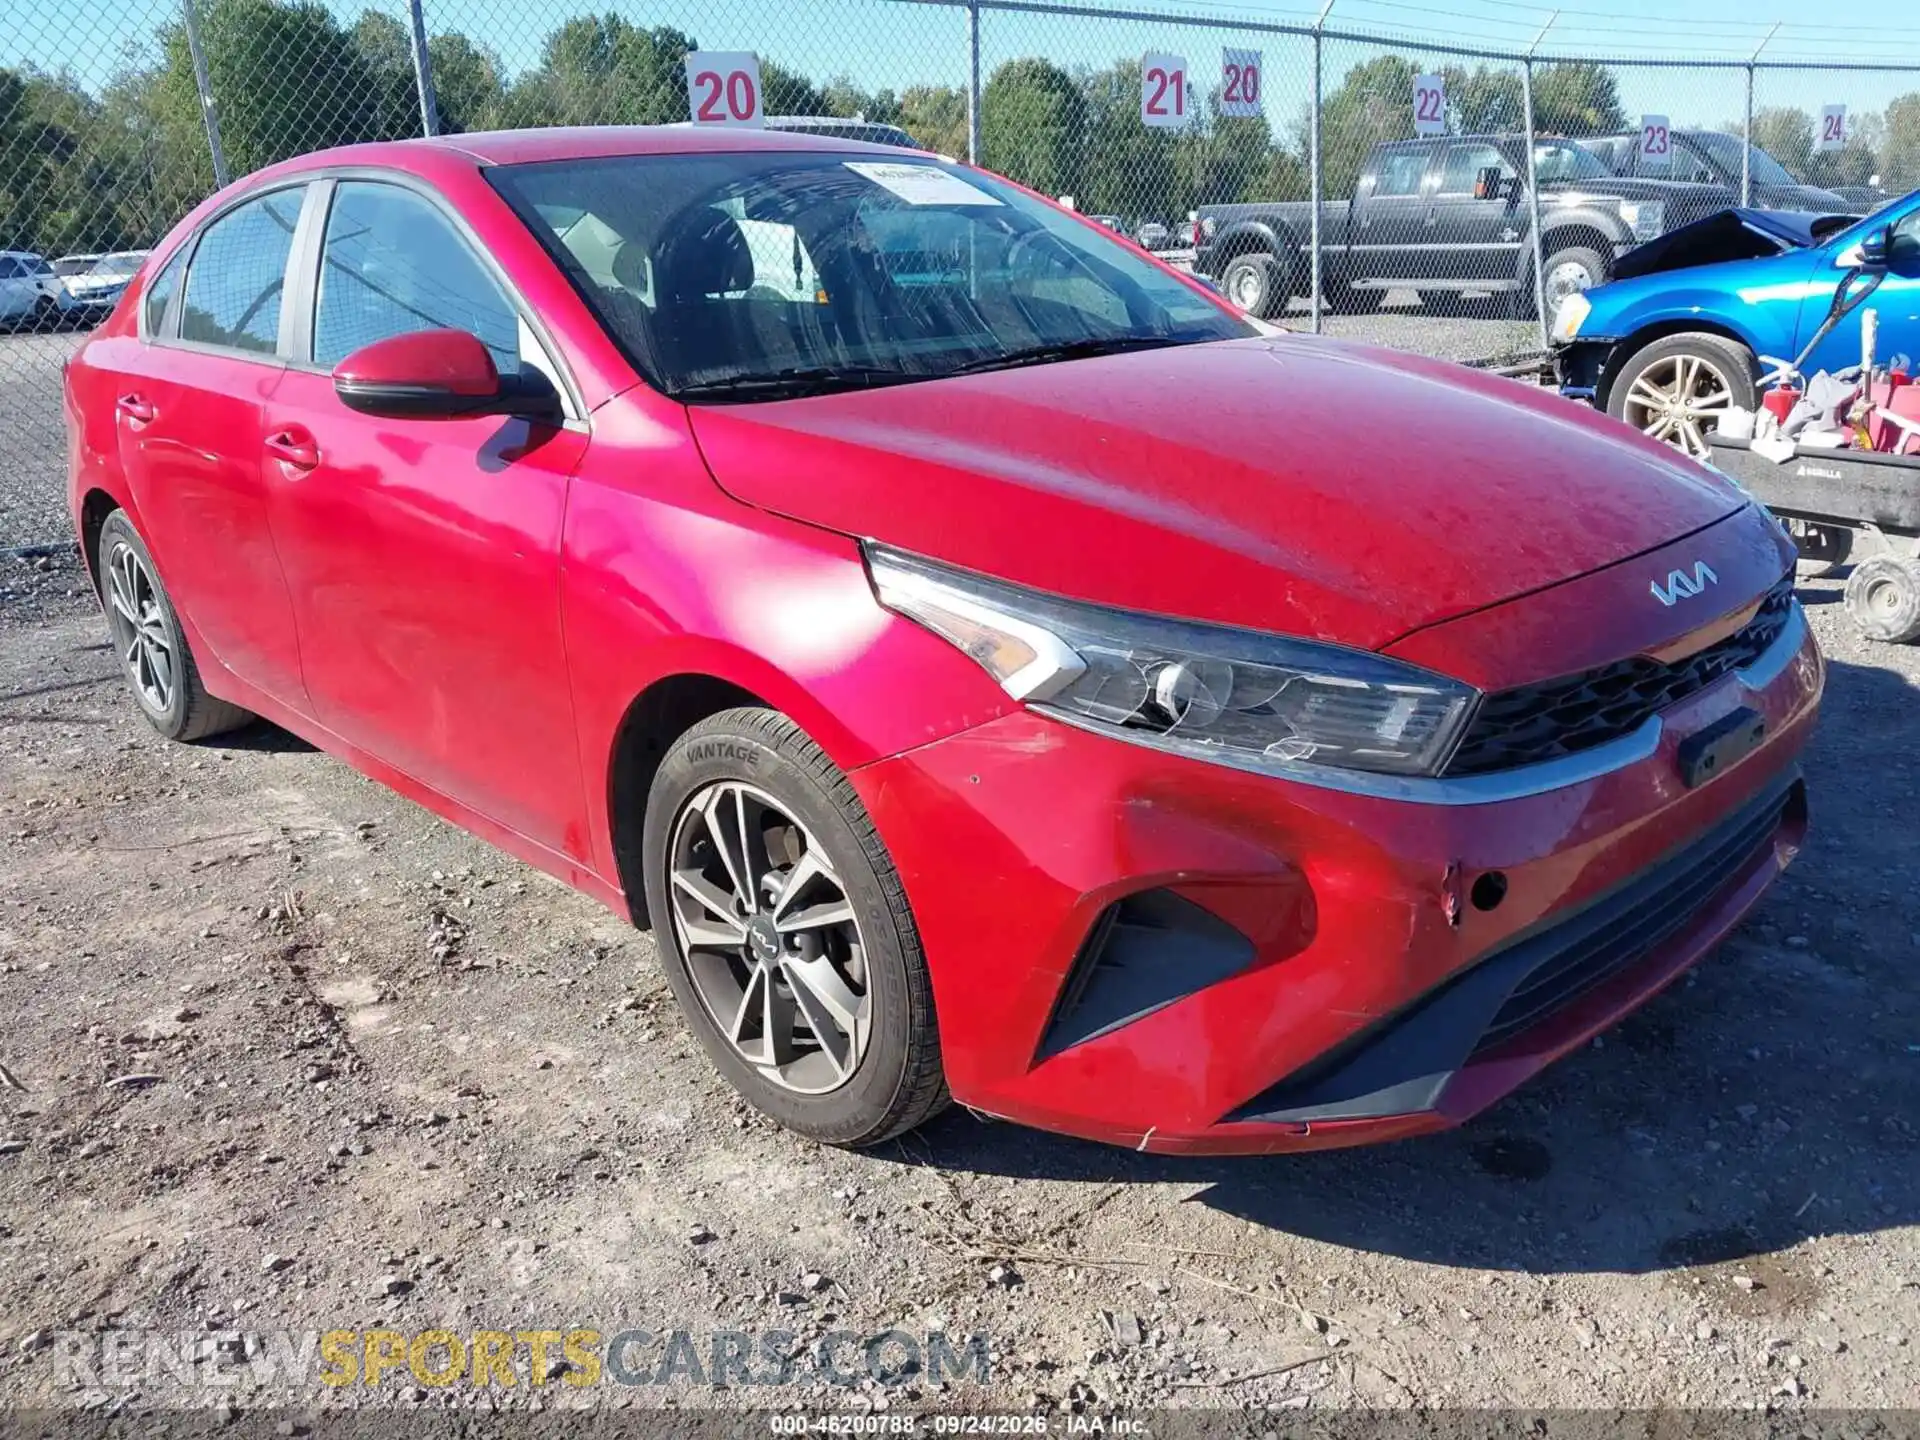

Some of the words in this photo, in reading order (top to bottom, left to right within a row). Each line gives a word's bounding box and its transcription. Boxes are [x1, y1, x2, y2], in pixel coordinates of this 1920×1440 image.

[694, 70, 756, 121] 20
[1146, 67, 1183, 116] 21
[1223, 63, 1259, 104] 20
[1417, 88, 1442, 122] 22
[1643, 125, 1668, 154] 23
[1823, 114, 1842, 142] 24
[686, 742, 760, 766] VANTAGE
